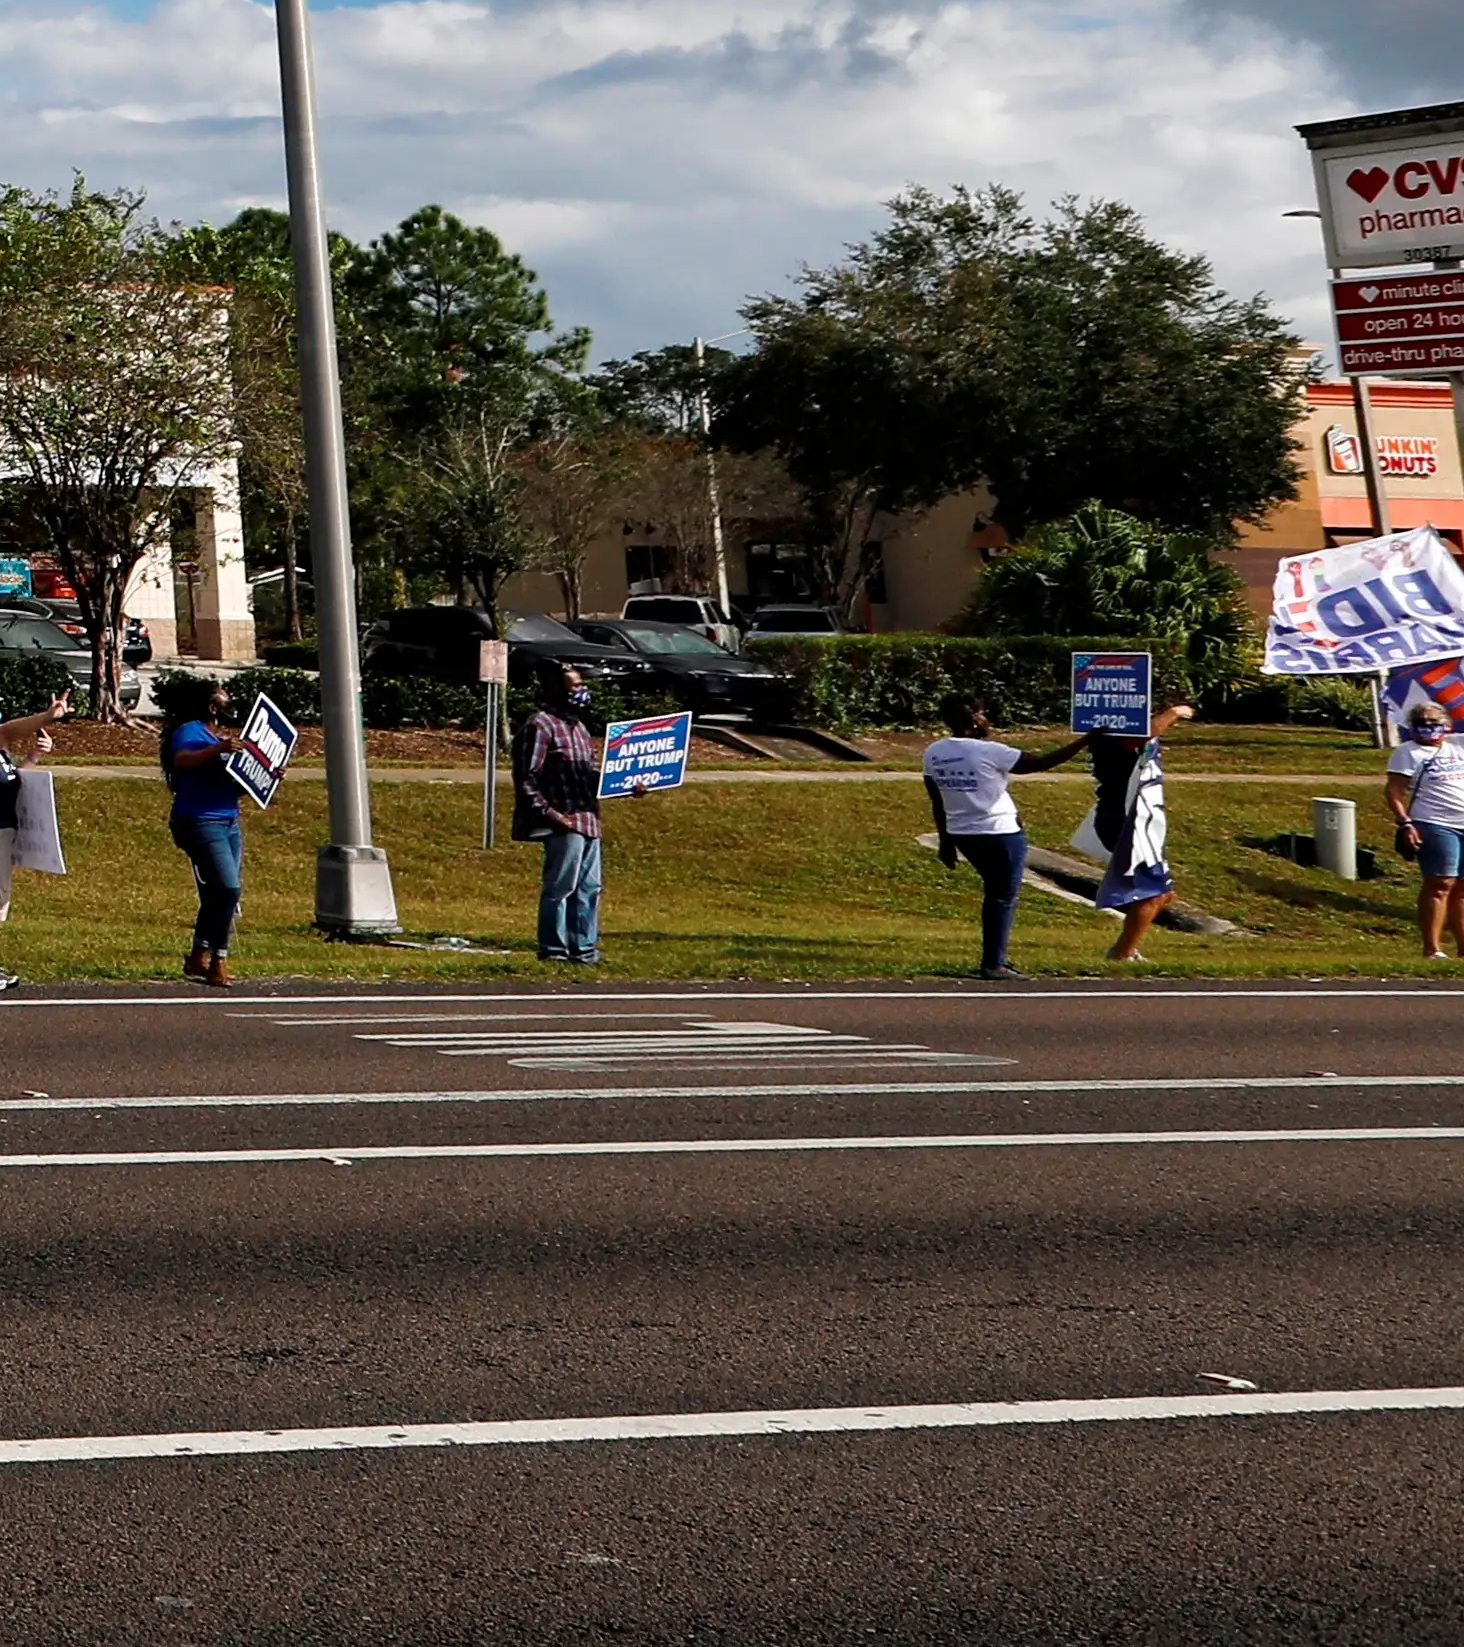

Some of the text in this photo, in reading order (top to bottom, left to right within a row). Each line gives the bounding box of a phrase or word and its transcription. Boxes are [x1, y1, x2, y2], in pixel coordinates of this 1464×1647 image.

[1393, 156, 1464, 200] CV
[1359, 205, 1464, 240] pharma
[1382, 282, 1441, 301] minute
[1364, 317, 1408, 336] open
[1412, 313, 1434, 330] 24
[1343, 345, 1427, 366] drive-thru
[1376, 438, 1437, 455] UNKIN'
[1378, 456, 1437, 473] ONUTS
[1084, 677, 1137, 692] ANYONE
[1075, 693, 1147, 709] BUT TRUMP
[248, 706, 288, 772] Dump
[618, 736, 677, 758] ANYONE
[605, 749, 685, 774] BUT TRUMP
